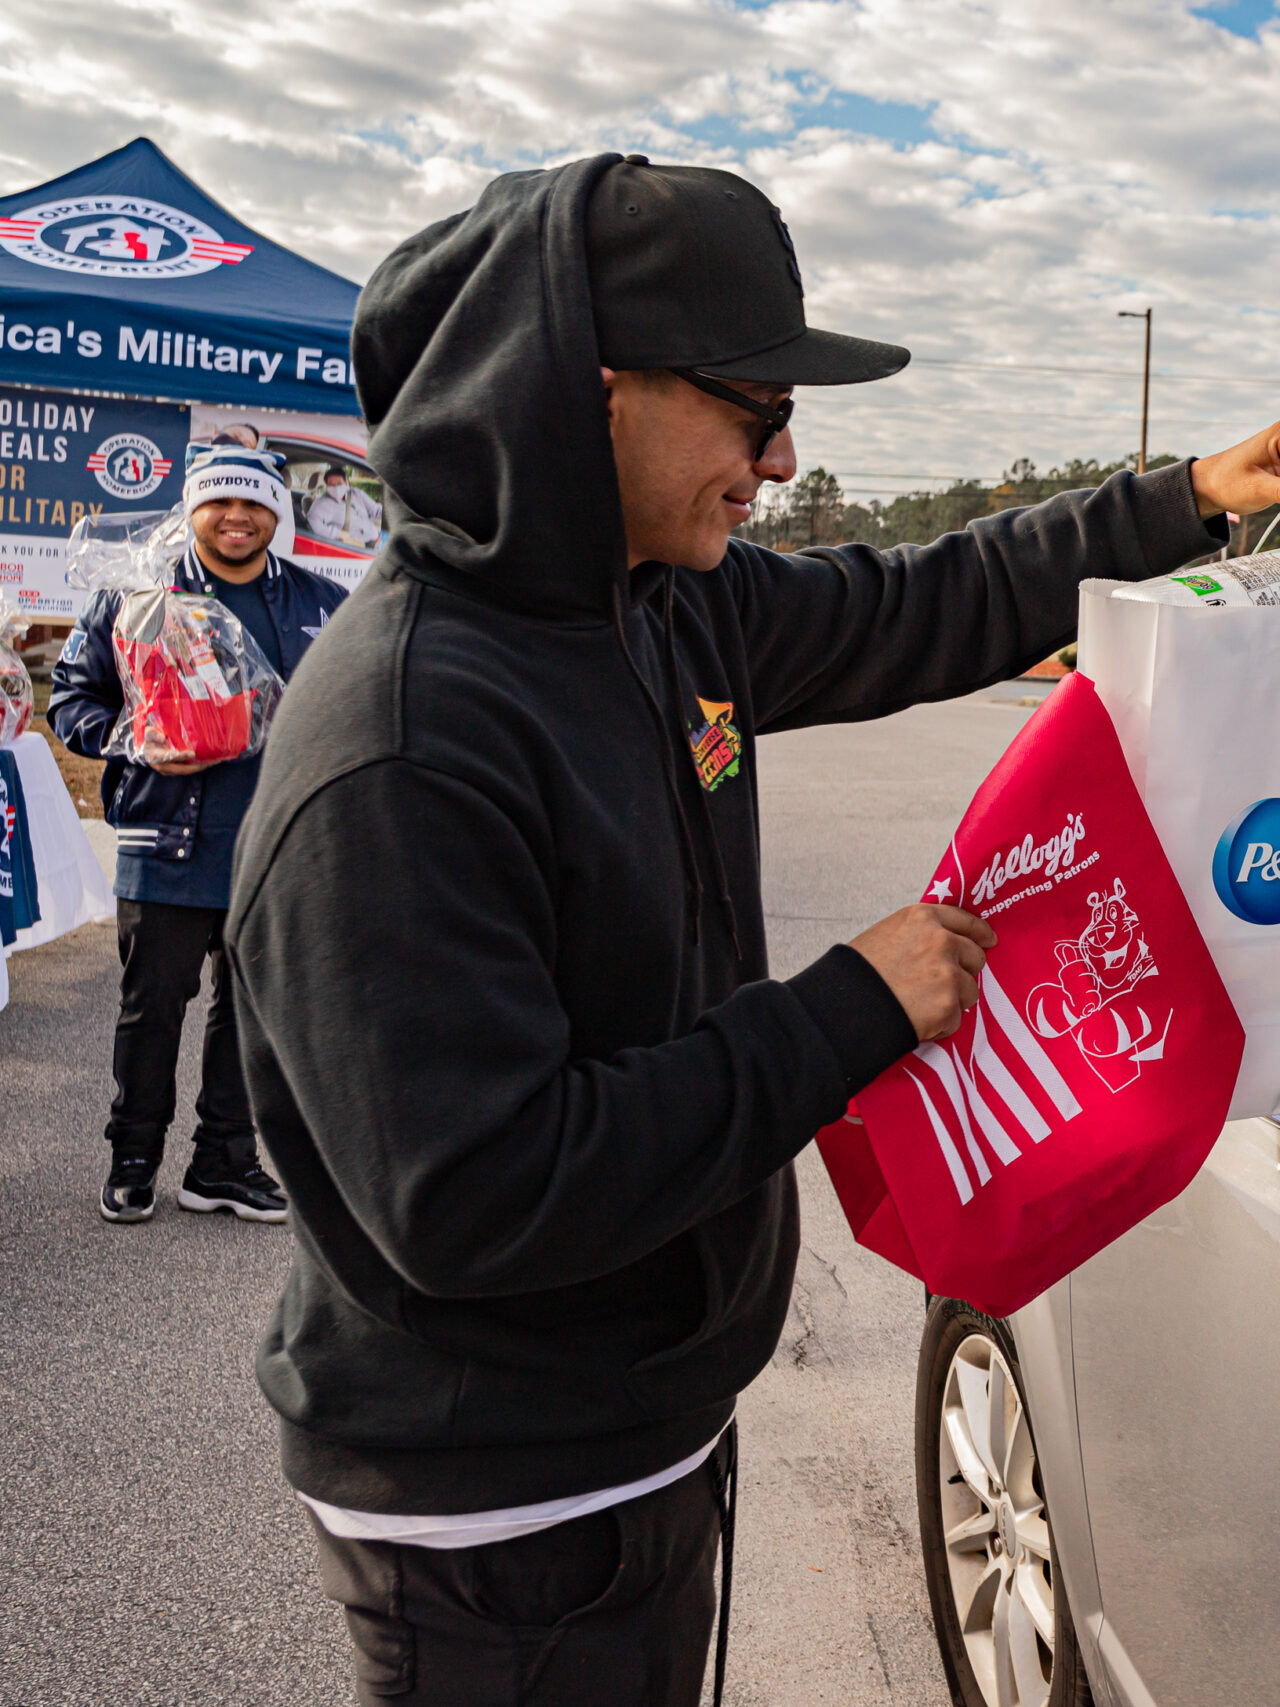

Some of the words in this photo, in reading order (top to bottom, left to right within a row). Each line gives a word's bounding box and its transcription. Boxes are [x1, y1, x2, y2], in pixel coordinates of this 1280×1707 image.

[37, 202, 204, 234] OPERATION
[18, 243, 199, 274] HOMEFRONT
[118, 326, 284, 384] Military
[296, 347, 357, 385] Fa
[0, 432, 68, 463] EALS
[198, 477, 260, 490] COWBOYS
[13, 545, 34, 557] YOU
[39, 547, 60, 558] FOR
[971, 812, 1085, 905] Kellogg's
[980, 880, 1053, 920] Supporting
[1054, 851, 1100, 884] Patrons
